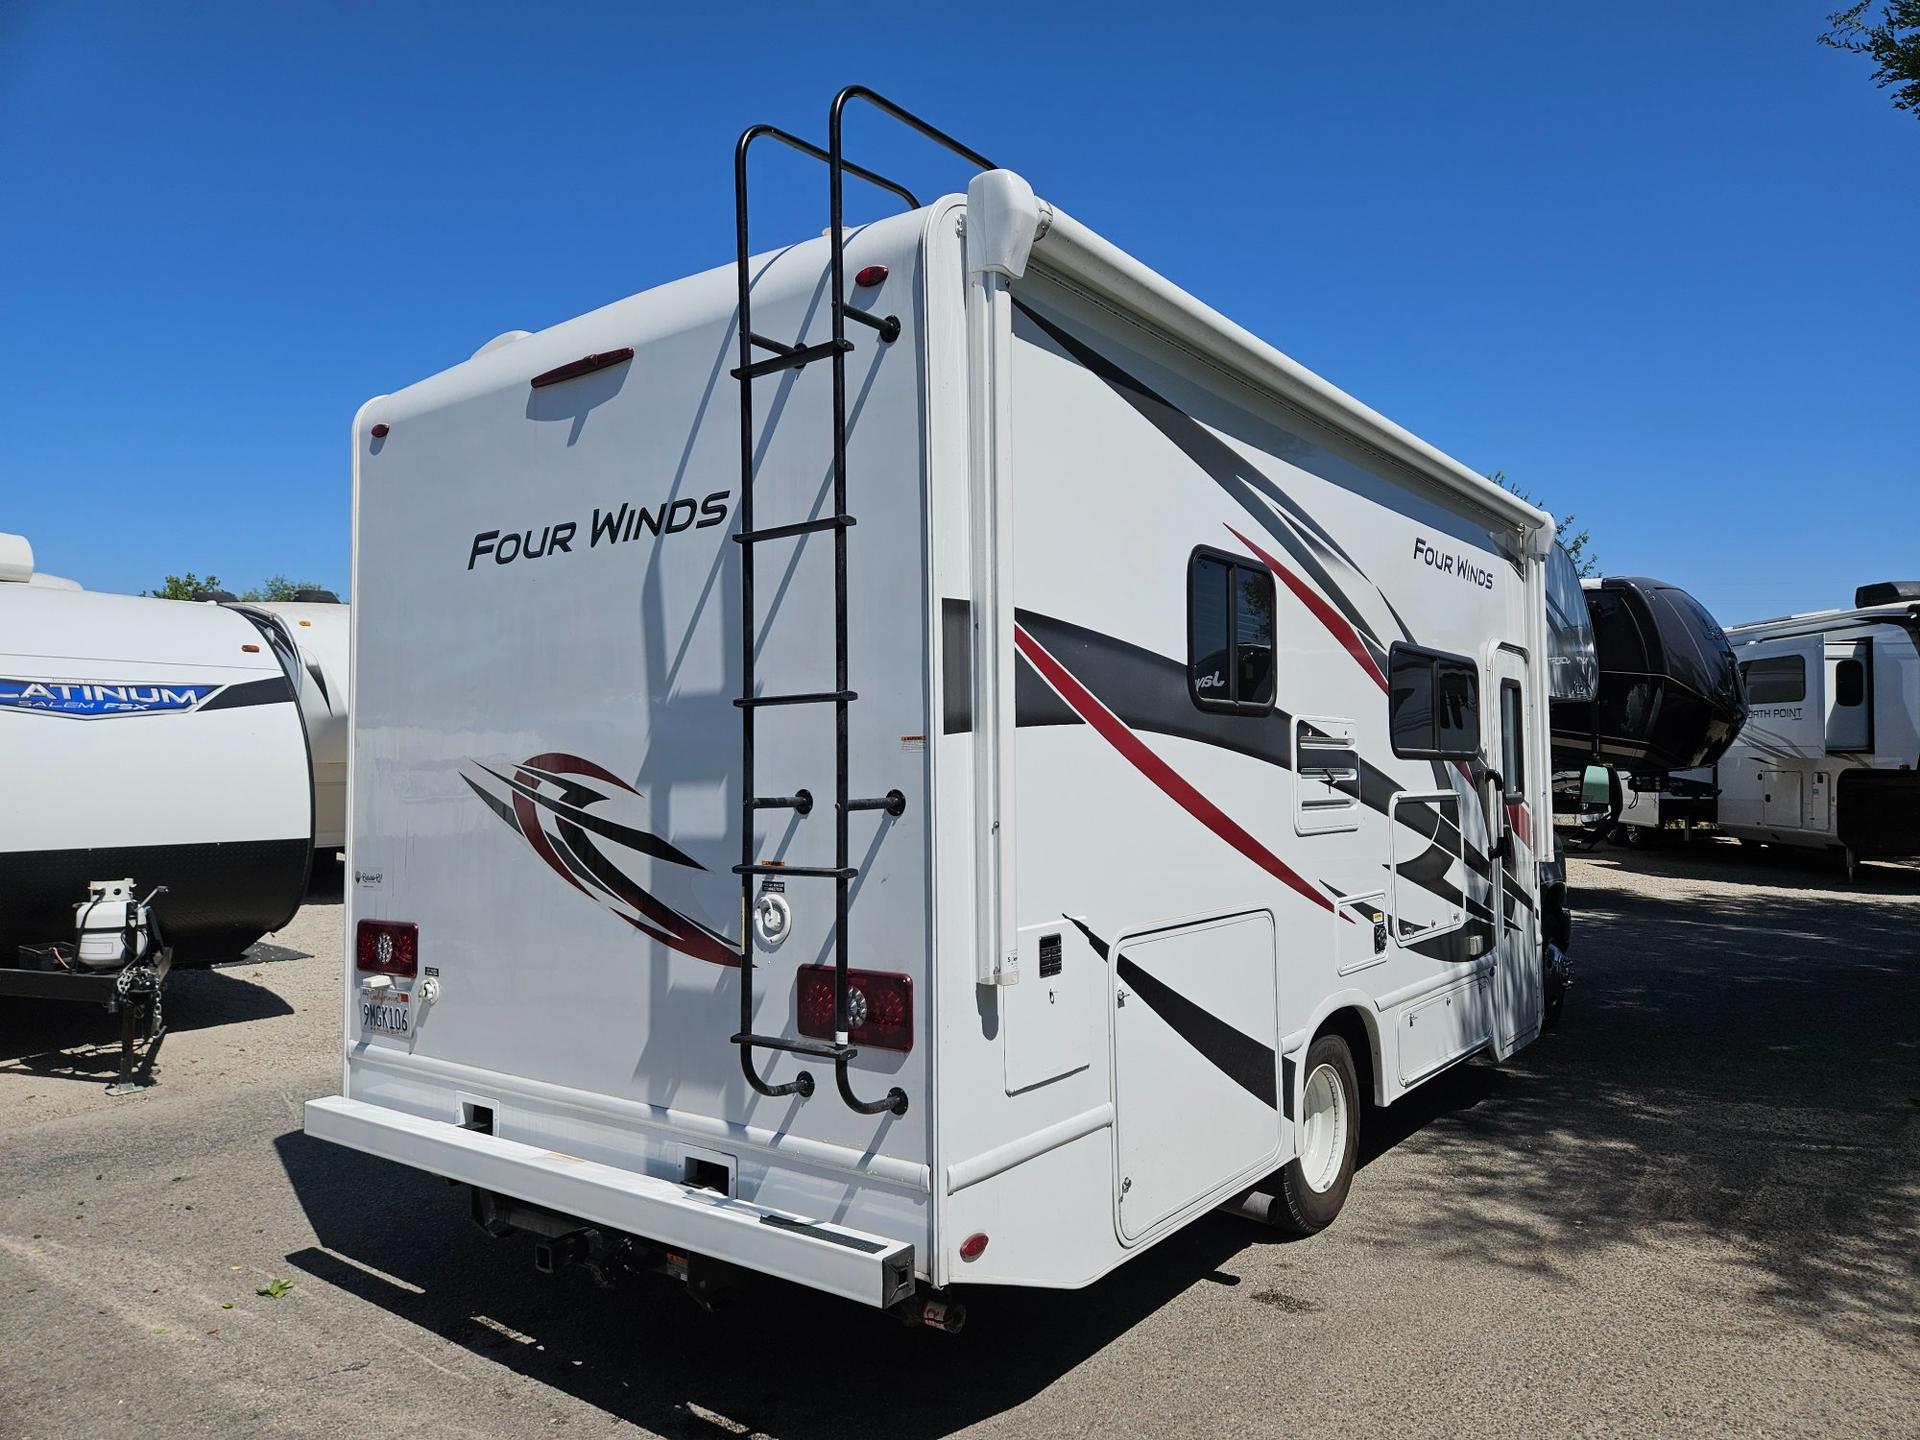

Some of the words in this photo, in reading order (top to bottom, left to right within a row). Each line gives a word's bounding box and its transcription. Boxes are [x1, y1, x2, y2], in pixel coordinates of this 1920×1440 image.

[467, 521, 577, 570] FOUR
[590, 490, 730, 548] WINDS
[1413, 537, 1453, 574] FOUR
[1457, 555, 1494, 590] WINDS
[18, 700, 95, 709] SALEM
[104, 702, 150, 711] FSX
[1748, 709, 1771, 719] ORTH
[1773, 708, 1803, 718] POINT
[363, 1003, 408, 1032] 9MGK106
